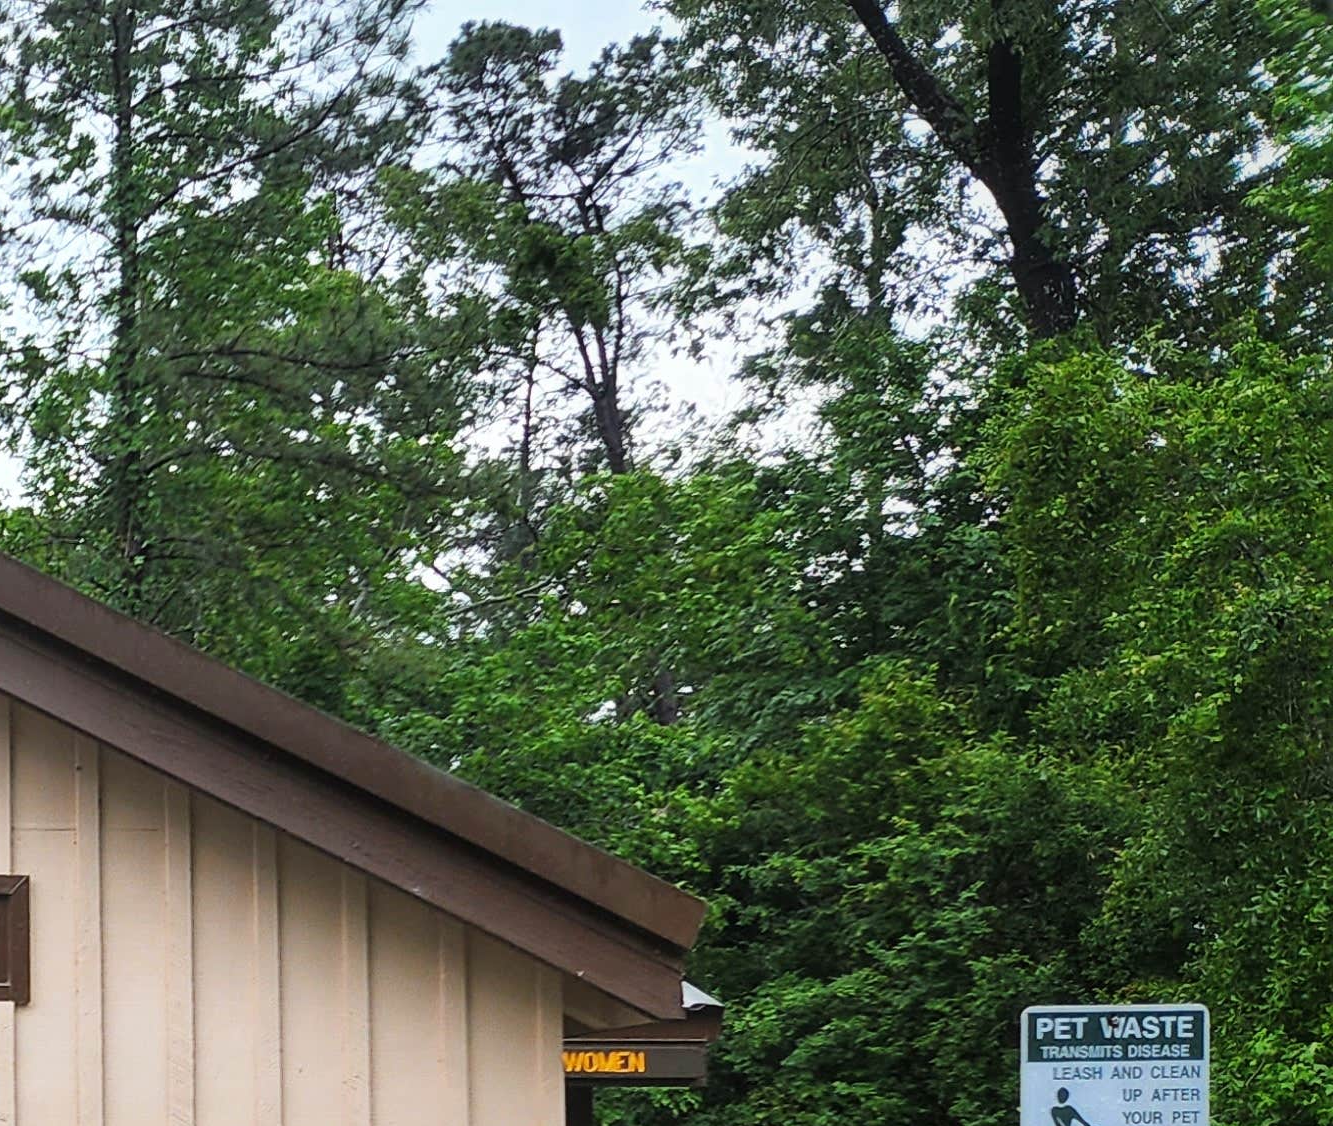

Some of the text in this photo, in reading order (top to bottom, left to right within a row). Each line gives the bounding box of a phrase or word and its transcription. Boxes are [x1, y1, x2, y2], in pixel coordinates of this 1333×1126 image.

[1035, 1016, 1195, 1040] PET WASTE
[1039, 1044, 1190, 1059] TRANSMITS DISEASE
[561, 1050, 646, 1073] WOMEN
[1052, 1065, 1201, 1081] LEASH AND CLEAN
[1122, 1087, 1201, 1102] UP AFTER
[1122, 1110, 1200, 1125] YOUR PET
